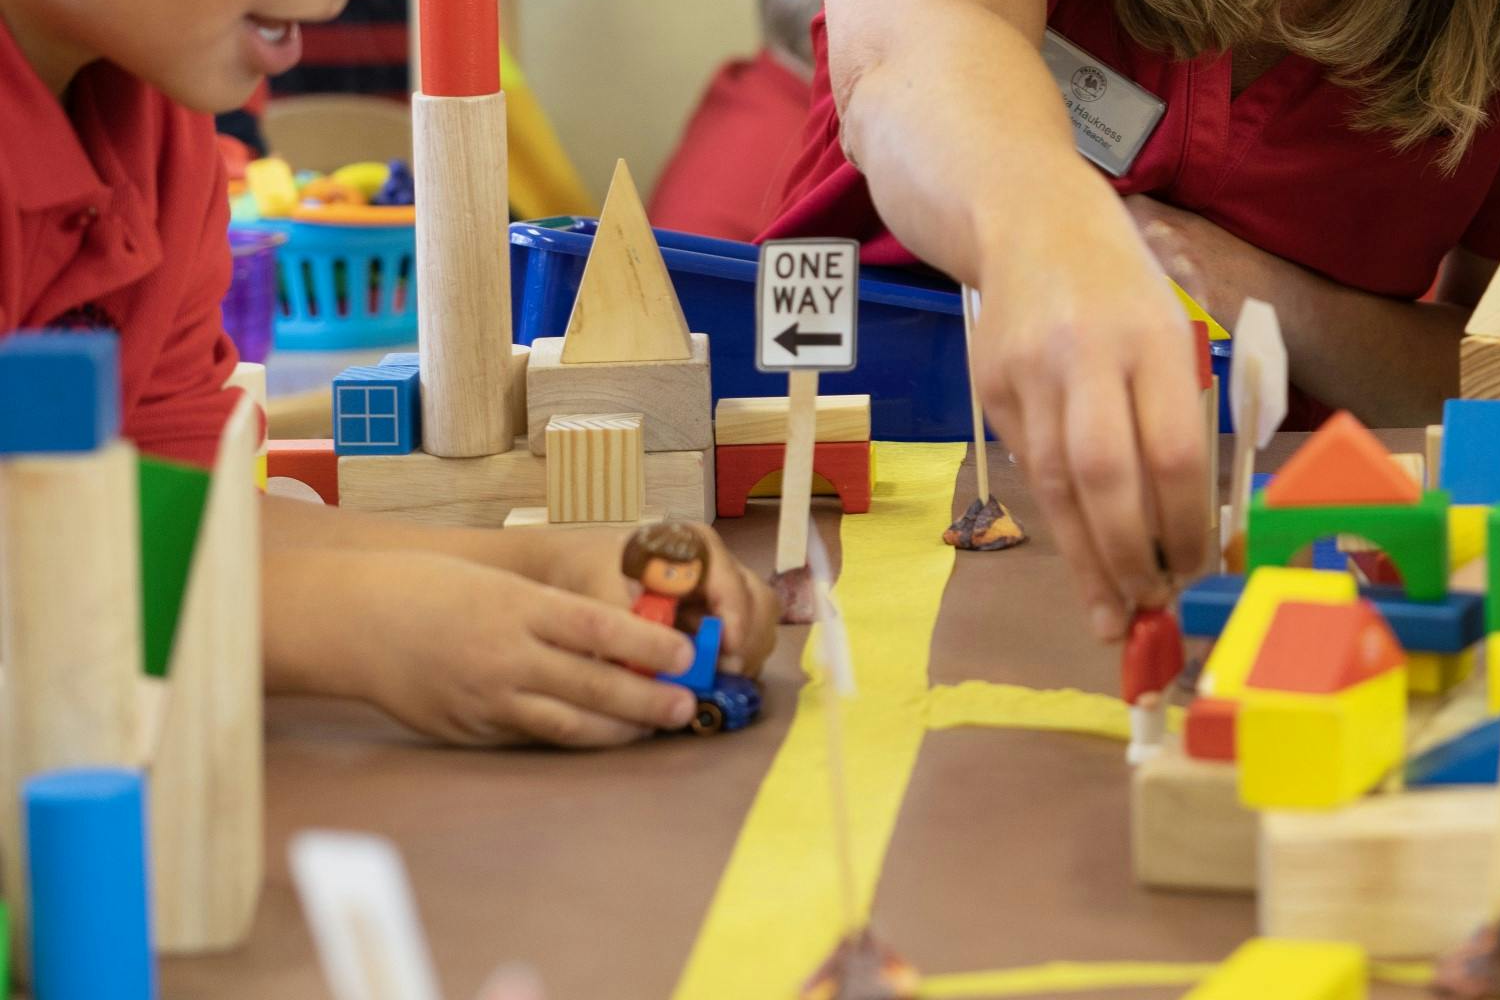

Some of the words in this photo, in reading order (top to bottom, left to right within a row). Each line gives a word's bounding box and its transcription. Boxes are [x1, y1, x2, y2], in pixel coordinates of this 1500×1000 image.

[1073, 103, 1122, 143] Haukness
[1083, 125, 1112, 149] Teacher
[775, 252, 844, 279] ONE
[773, 285, 843, 314] WAY
